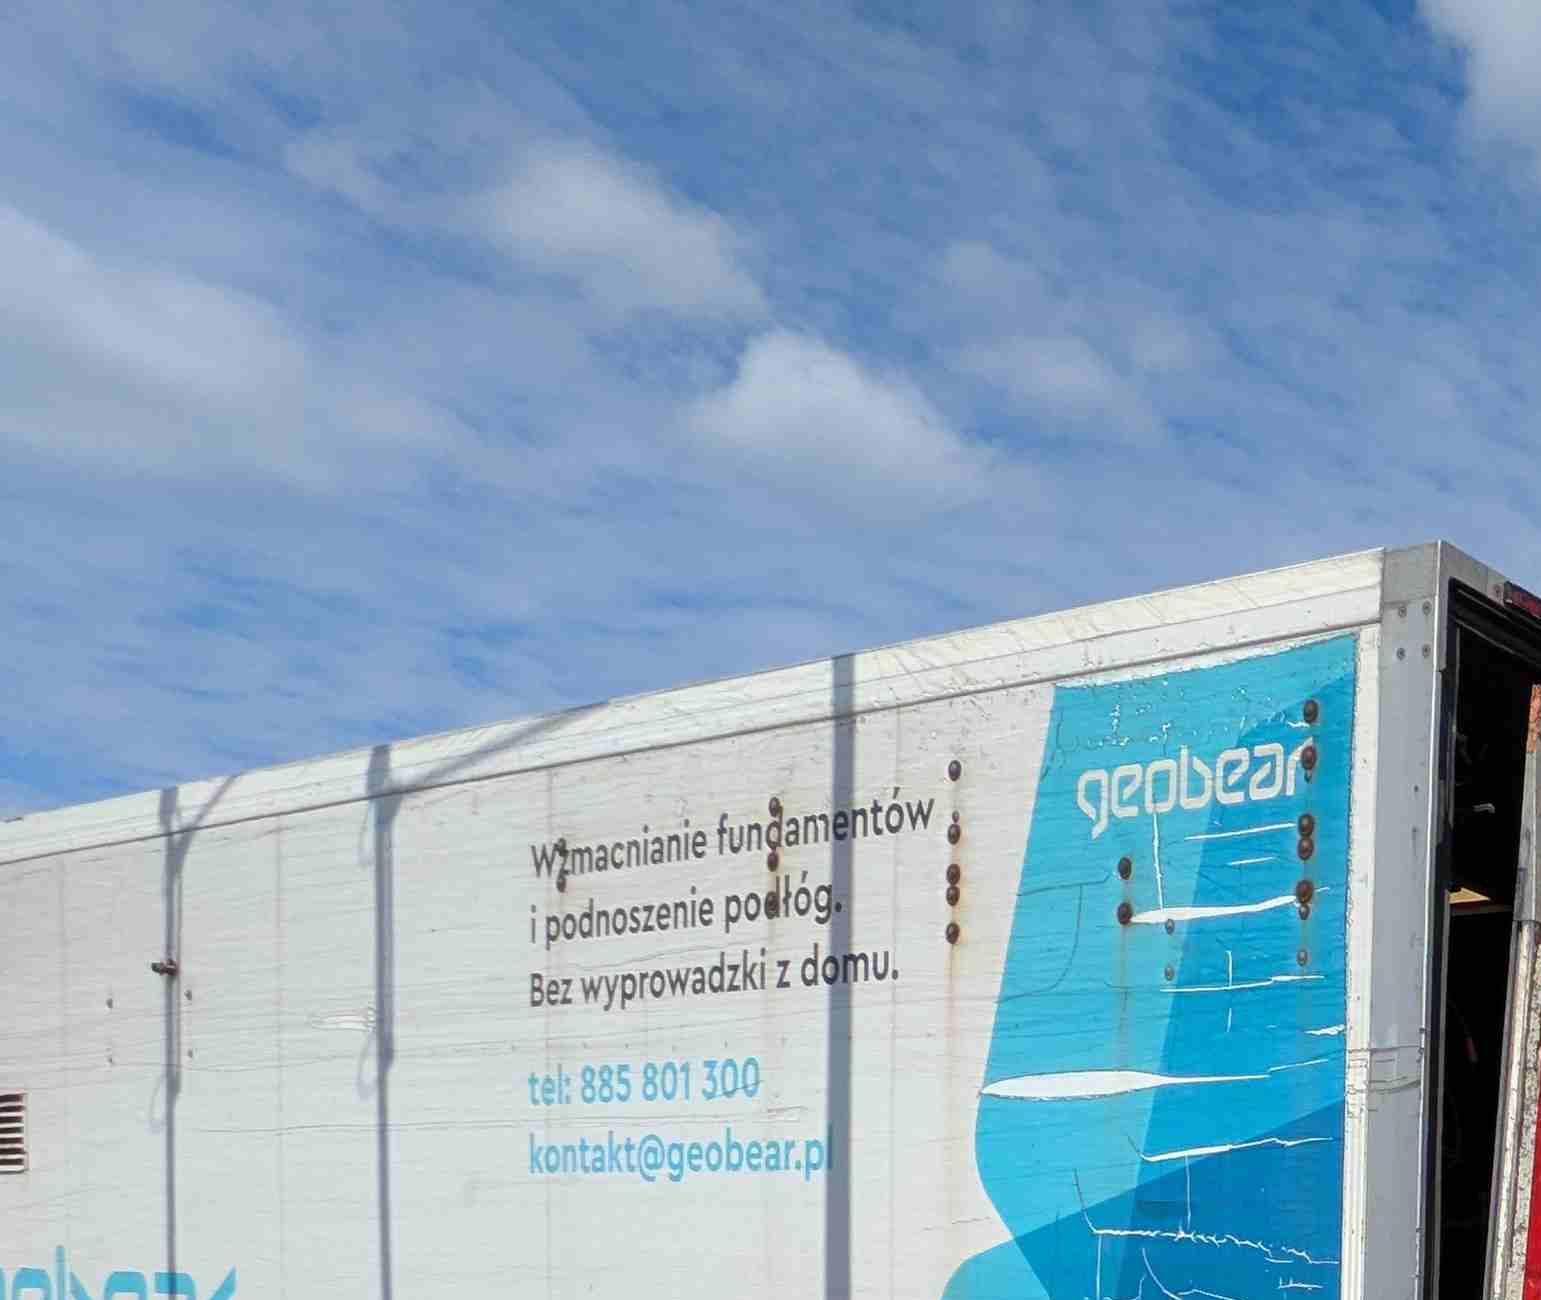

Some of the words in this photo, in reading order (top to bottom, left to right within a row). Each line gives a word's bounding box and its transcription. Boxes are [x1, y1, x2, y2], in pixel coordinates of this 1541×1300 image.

[1077, 737, 1313, 840] geobear
[531, 820, 707, 877] Wzmacnianie
[716, 786, 935, 854] fundamentów
[530, 905, 537, 943] i
[546, 886, 714, 950] podnoszenie
[725, 870, 843, 932] podłóg.
[530, 972, 573, 1008] Bez
[581, 947, 767, 1011] wyprowadzki
[776, 960, 791, 989] z
[800, 943, 899, 987] domu.
[581, 1064, 631, 1104] 885
[642, 1061, 691, 1101] 801
[701, 1057, 761, 1099] 300
[528, 1122, 834, 1182] kontakt@geobear.pl
